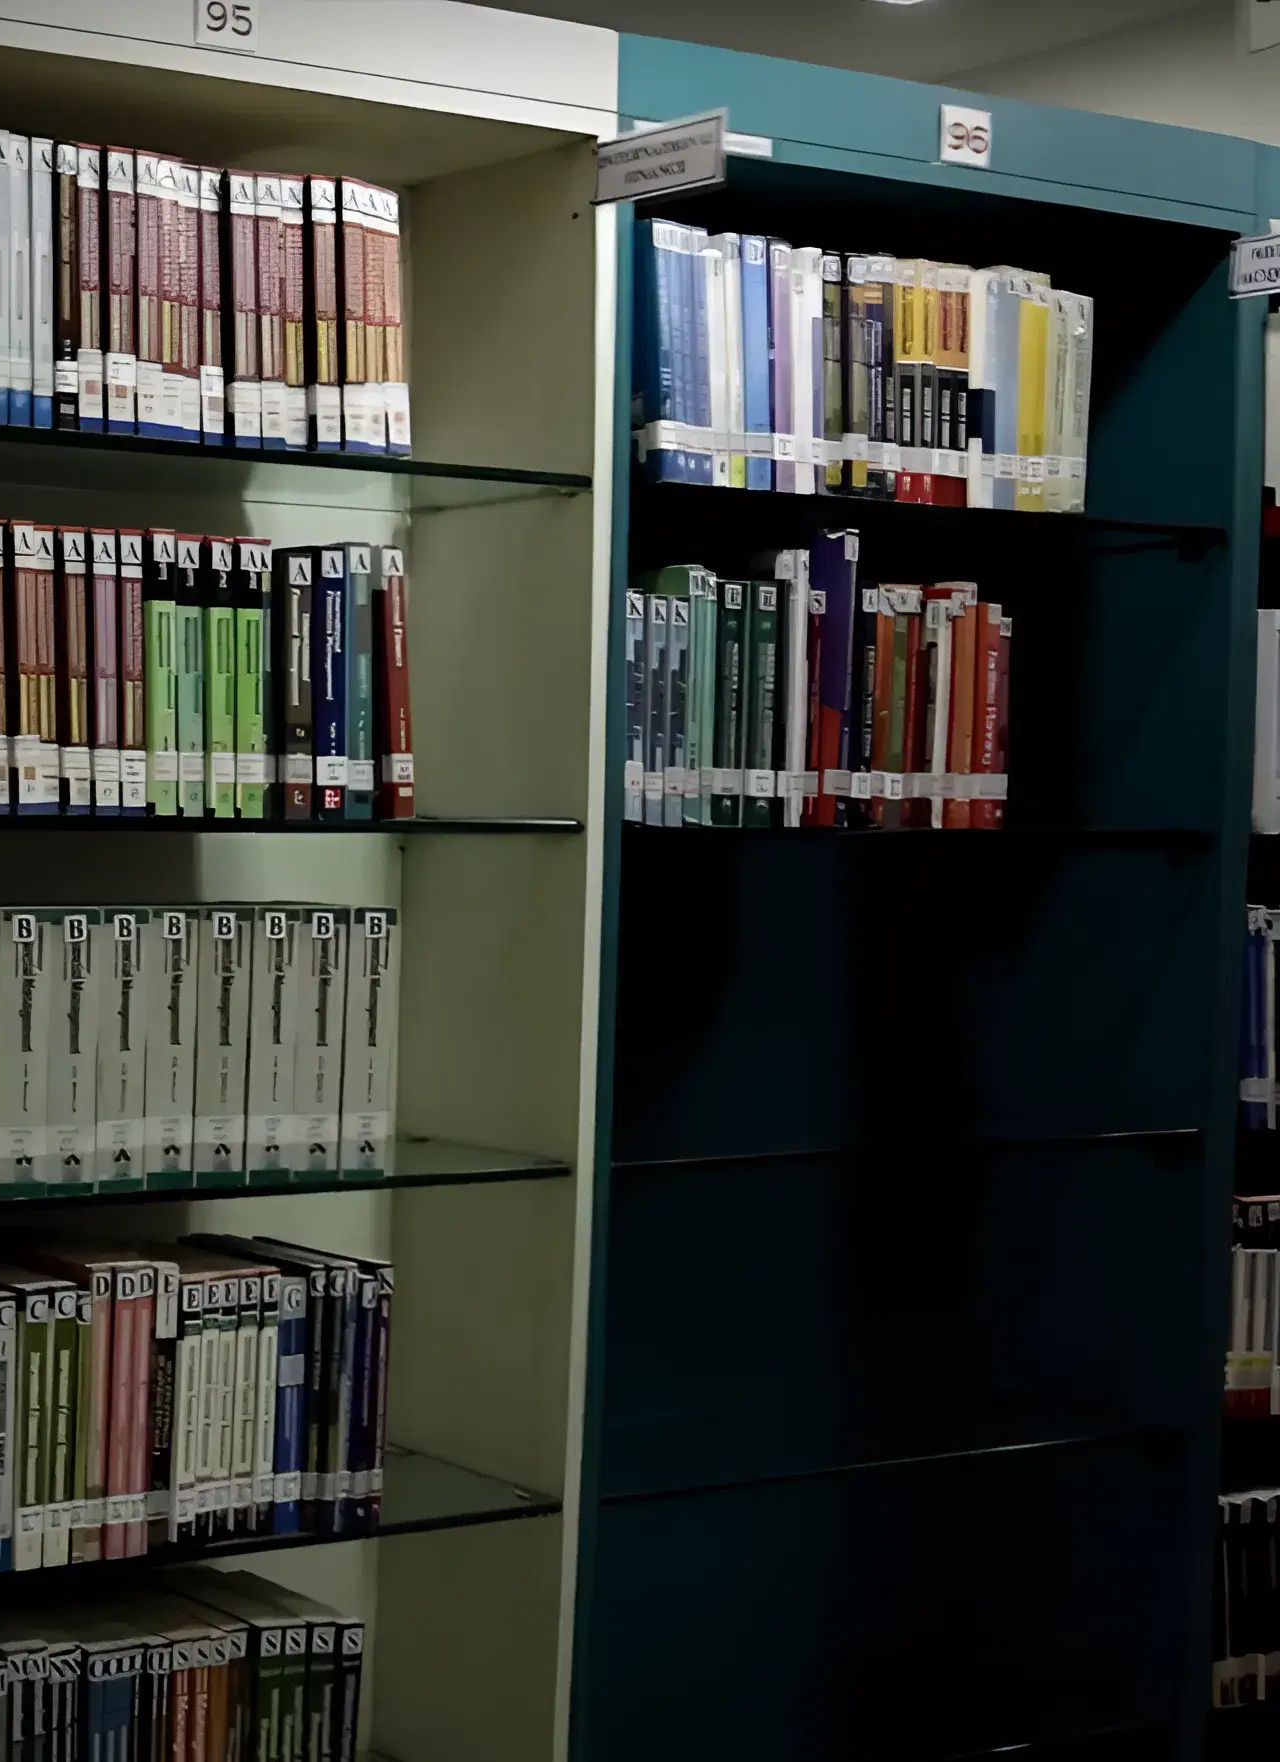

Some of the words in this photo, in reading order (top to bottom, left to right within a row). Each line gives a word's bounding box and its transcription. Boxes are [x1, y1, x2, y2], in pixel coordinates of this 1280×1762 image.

[206, 1, 253, 37] 95
[948, 122, 989, 154] 96
[18, 532, 30, 551] A
[37, 537, 52, 558] A
[68, 538, 83, 558] A
[96, 542, 112, 560] A
[124, 542, 139, 560] A
[160, 541, 171, 559] A
[218, 549, 227, 566] A
[249, 551, 257, 568] A
[326, 556, 337, 575] A
[356, 554, 368, 571] A
[295, 563, 308, 582] A
[18, 918, 31, 937] B
[69, 919, 83, 938] B
[119, 919, 132, 936] B
[168, 916, 181, 936] B
[218, 917, 232, 935] B
[270, 917, 283, 935] B
[318, 916, 329, 935] B
[370, 917, 381, 935] B
[97, 1276, 109, 1296] D
[123, 1276, 135, 1296] D
[141, 1274, 152, 1292] D
[58, 1295, 73, 1316] C
[288, 1290, 300, 1309] G
[30, 1300, 46, 1320] C
